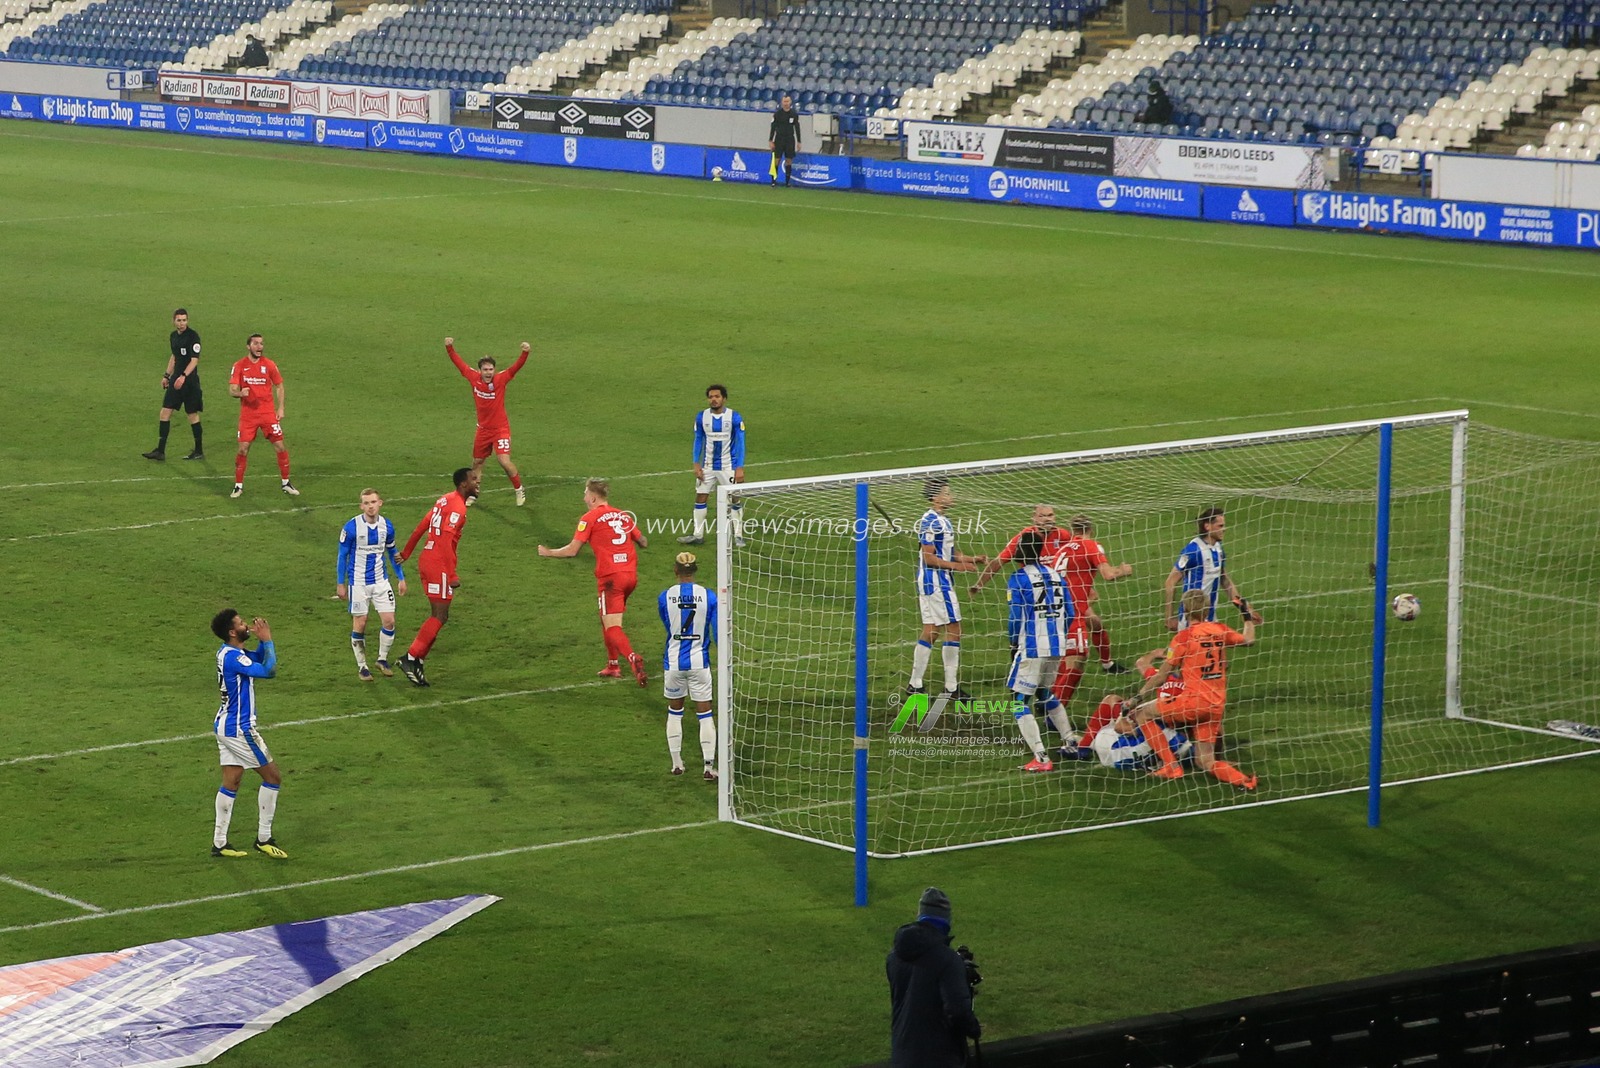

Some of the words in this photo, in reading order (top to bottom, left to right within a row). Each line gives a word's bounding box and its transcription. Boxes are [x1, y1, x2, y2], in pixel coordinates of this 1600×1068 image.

[127, 73, 141, 86] 30
[164, 80, 198, 94] RadianB
[207, 82, 241, 97] RadianB
[250, 85, 286, 101] RadianB
[293, 88, 318, 112] COVONIA
[328, 90, 355, 115] COVONIA
[361, 93, 389, 117] COVONIA
[467, 94, 478, 107] 29
[56, 98, 86, 121] Haighs
[88, 101, 109, 118] Farm
[111, 102, 133, 125] Shop
[398, 96, 425, 120] COVONIA
[195, 109, 203, 119] Do
[204, 111, 236, 124] something
[267, 114, 284, 125] foster
[285, 117, 290, 126] a
[290, 116, 305, 127] child
[524, 110, 556, 122] UMBRO.CO.UK
[589, 115, 621, 126] UMBRO.CO.UK
[497, 120, 519, 130] umbro
[561, 125, 584, 135] umbro
[869, 122, 882, 135] 28
[327, 129, 365, 138] www.htafc.com
[390, 126, 416, 138] Chadwick
[417, 129, 443, 140] Lawrence
[468, 132, 496, 145] Chadwick
[496, 135, 524, 147] Lawrence
[626, 130, 650, 140] umbro
[918, 129, 986, 152] STAFFLEX
[1178, 145, 1207, 158] BBC
[1208, 147, 1241, 159] RADIO
[1243, 149, 1275, 161] LEEDS
[1382, 154, 1399, 169] 27
[722, 170, 760, 180] DVERTISING
[801, 171, 830, 180] solutions
[850, 165, 893, 179] Integrated
[896, 168, 931, 181] Business
[934, 171, 970, 183] Services
[903, 183, 970, 195] www.complete.co.uk
[1008, 176, 1071, 193] THORNHILL
[1118, 184, 1185, 202] THORNHILL
[1231, 212, 1266, 222] EVENTS
[1329, 194, 1390, 228] Haighs
[1393, 199, 1436, 227] Farm
[1440, 203, 1487, 237] Shop
[497, 439, 510, 449] 35
[608, 520, 627, 545] 3
[677, 603, 697, 633] 7
